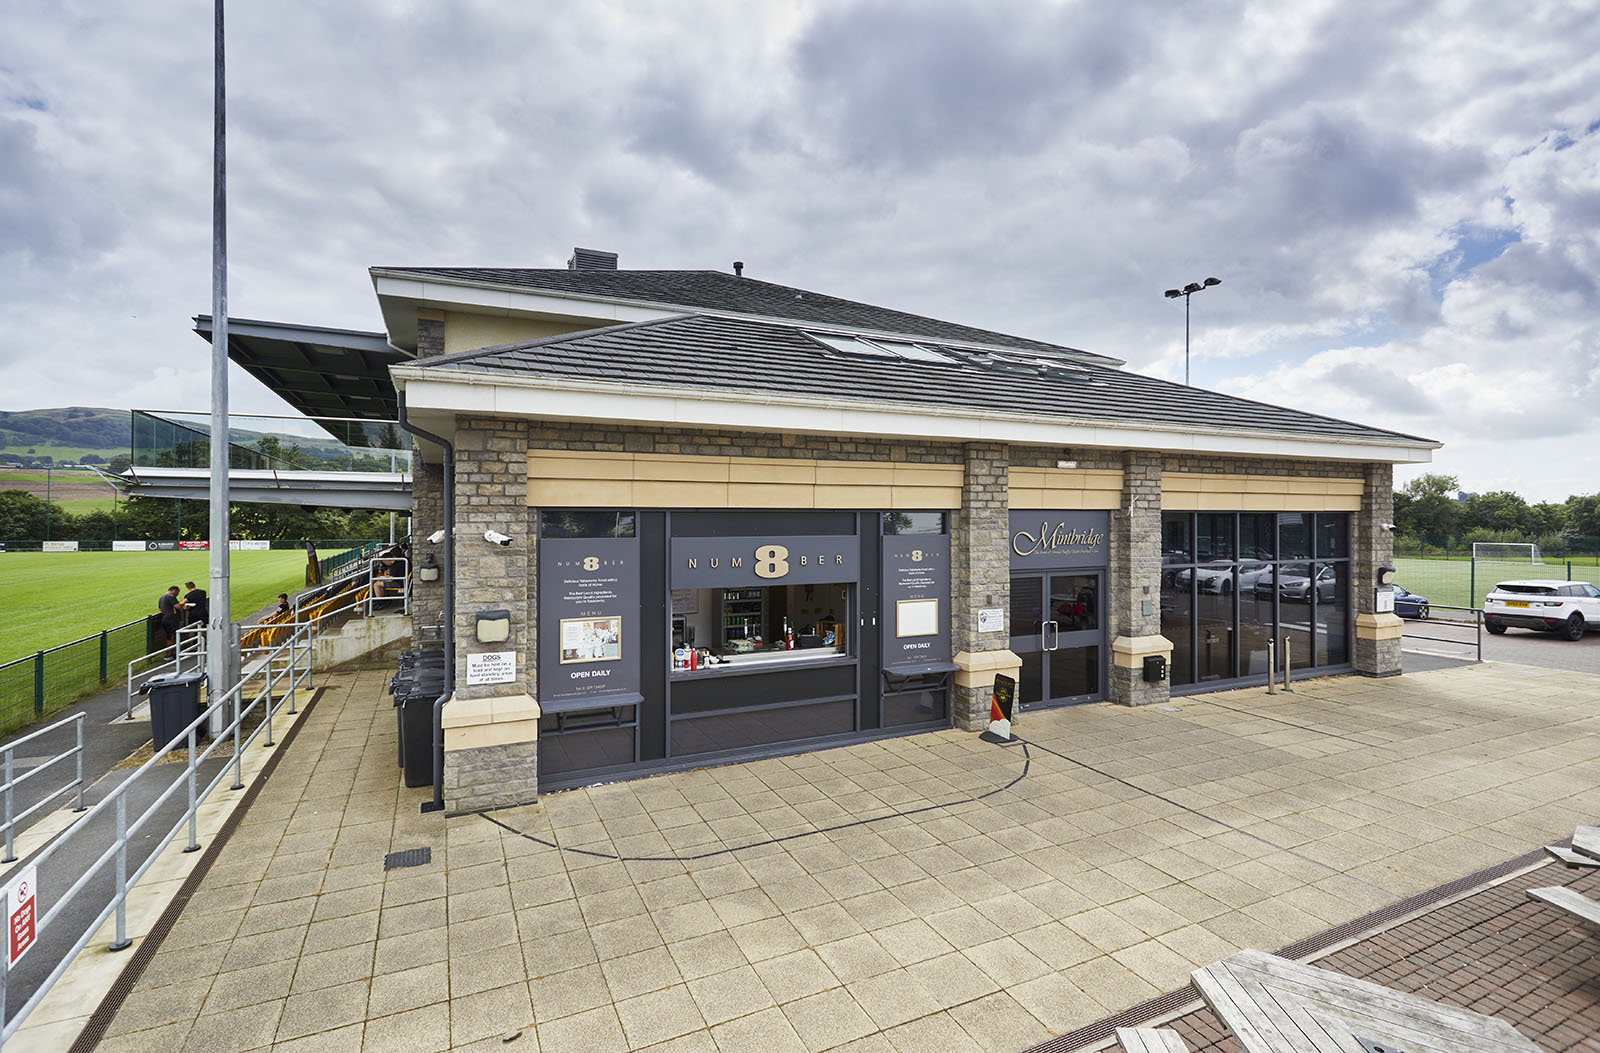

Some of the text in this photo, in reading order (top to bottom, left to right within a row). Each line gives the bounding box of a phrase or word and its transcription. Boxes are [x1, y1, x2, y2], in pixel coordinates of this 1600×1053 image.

[1013, 521, 1104, 556] Mintbridge
[570, 669, 611, 679] OPEN DAILY
[14, 904, 32, 926] No Dogs
